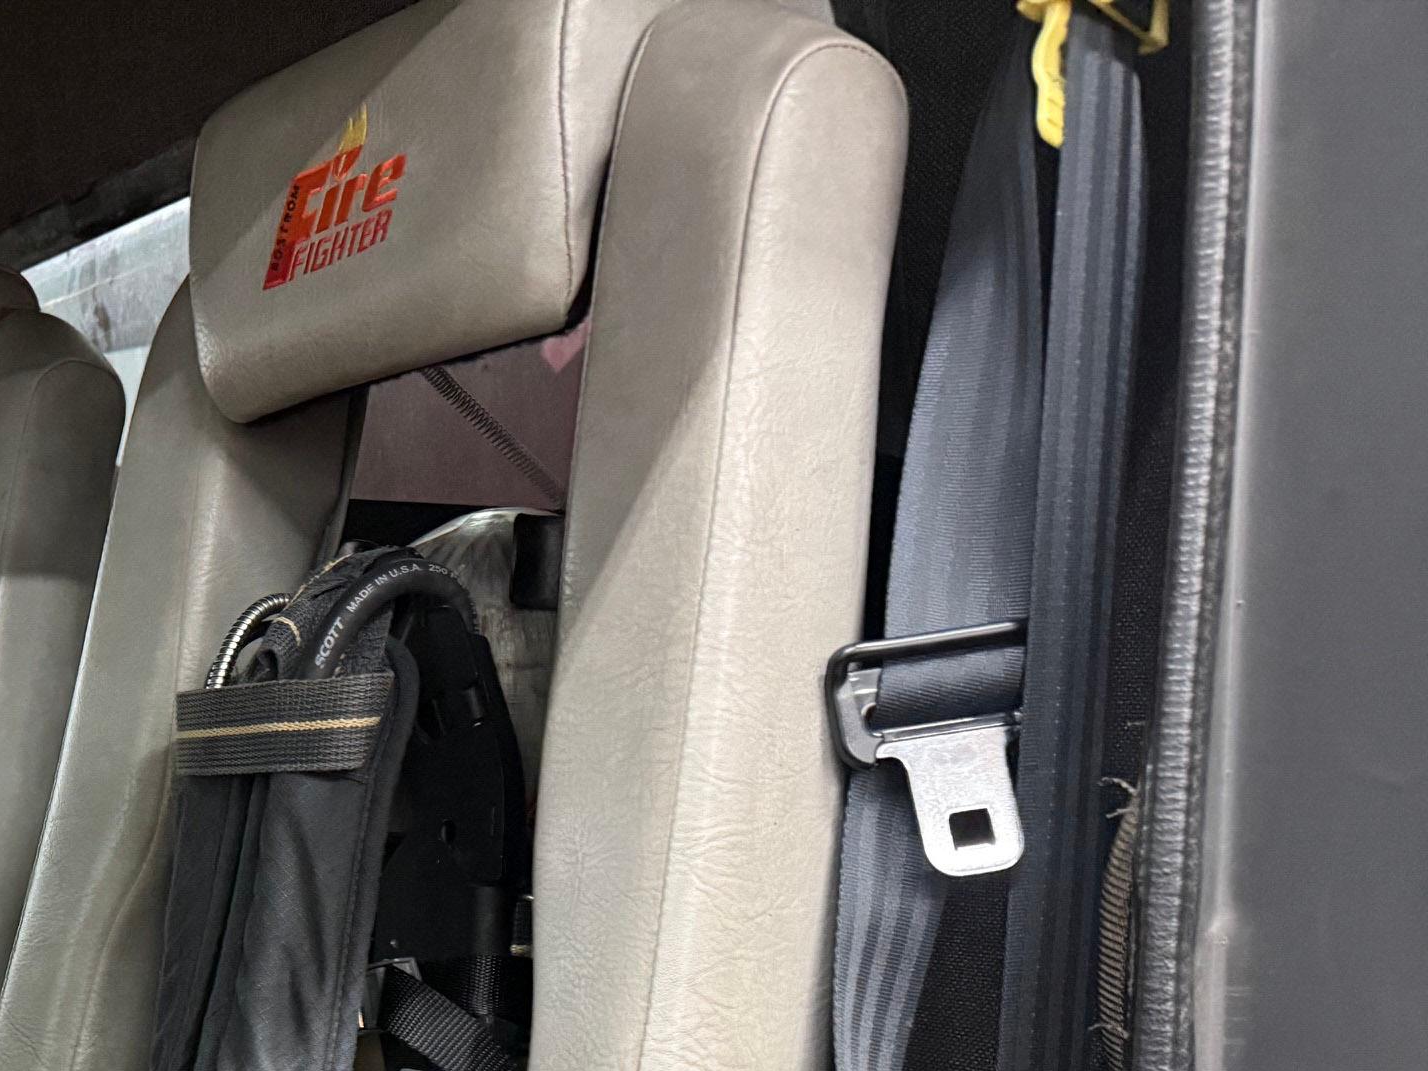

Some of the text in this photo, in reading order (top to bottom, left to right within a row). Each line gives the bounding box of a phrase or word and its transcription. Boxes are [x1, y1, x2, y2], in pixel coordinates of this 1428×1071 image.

[264, 146, 407, 290] Fire
[289, 209, 393, 282] FIGHTER
[314, 616, 345, 669] SCOTT
[346, 583, 374, 613] MADE
[375, 574, 388, 586] IN
